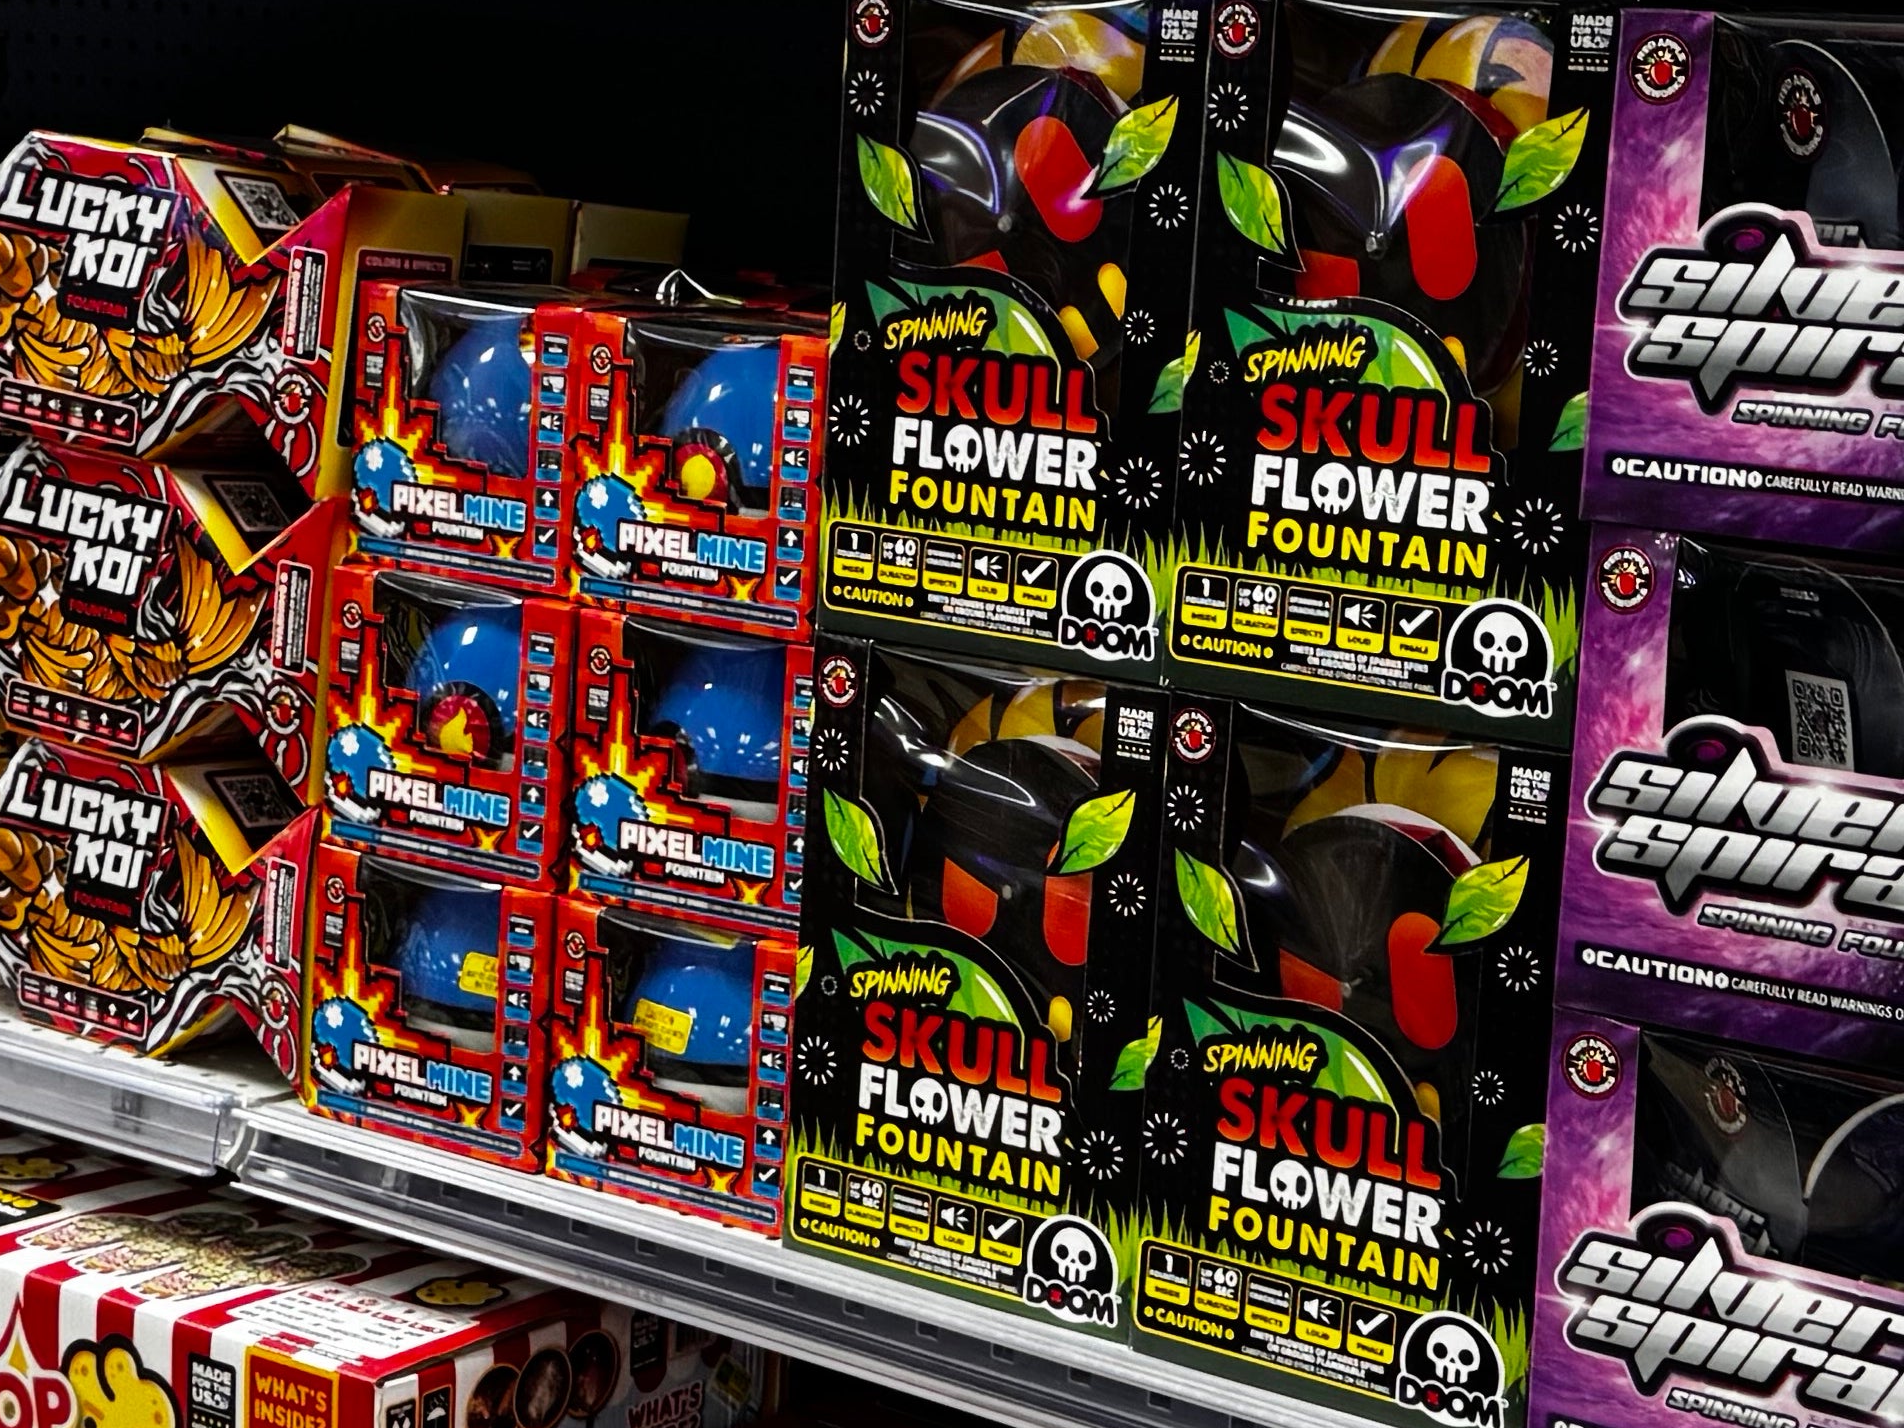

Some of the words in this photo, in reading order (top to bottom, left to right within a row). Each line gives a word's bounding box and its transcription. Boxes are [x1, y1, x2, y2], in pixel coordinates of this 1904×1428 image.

[5, 172, 170, 244] LUCKY
[69, 235, 148, 290] KOI
[1257, 381, 1491, 472] SKULL
[1250, 453, 1491, 534] FLOWER
[1247, 511, 1488, 580] FOUNTAIN
[1193, 634, 1262, 660] CAUTION
[862, 1000, 1064, 1103] SKULL
[858, 1063, 1064, 1156] FLOWER
[856, 1114, 1061, 1196] FOUNTAIN
[254, 1371, 329, 1412] WHAT'S
